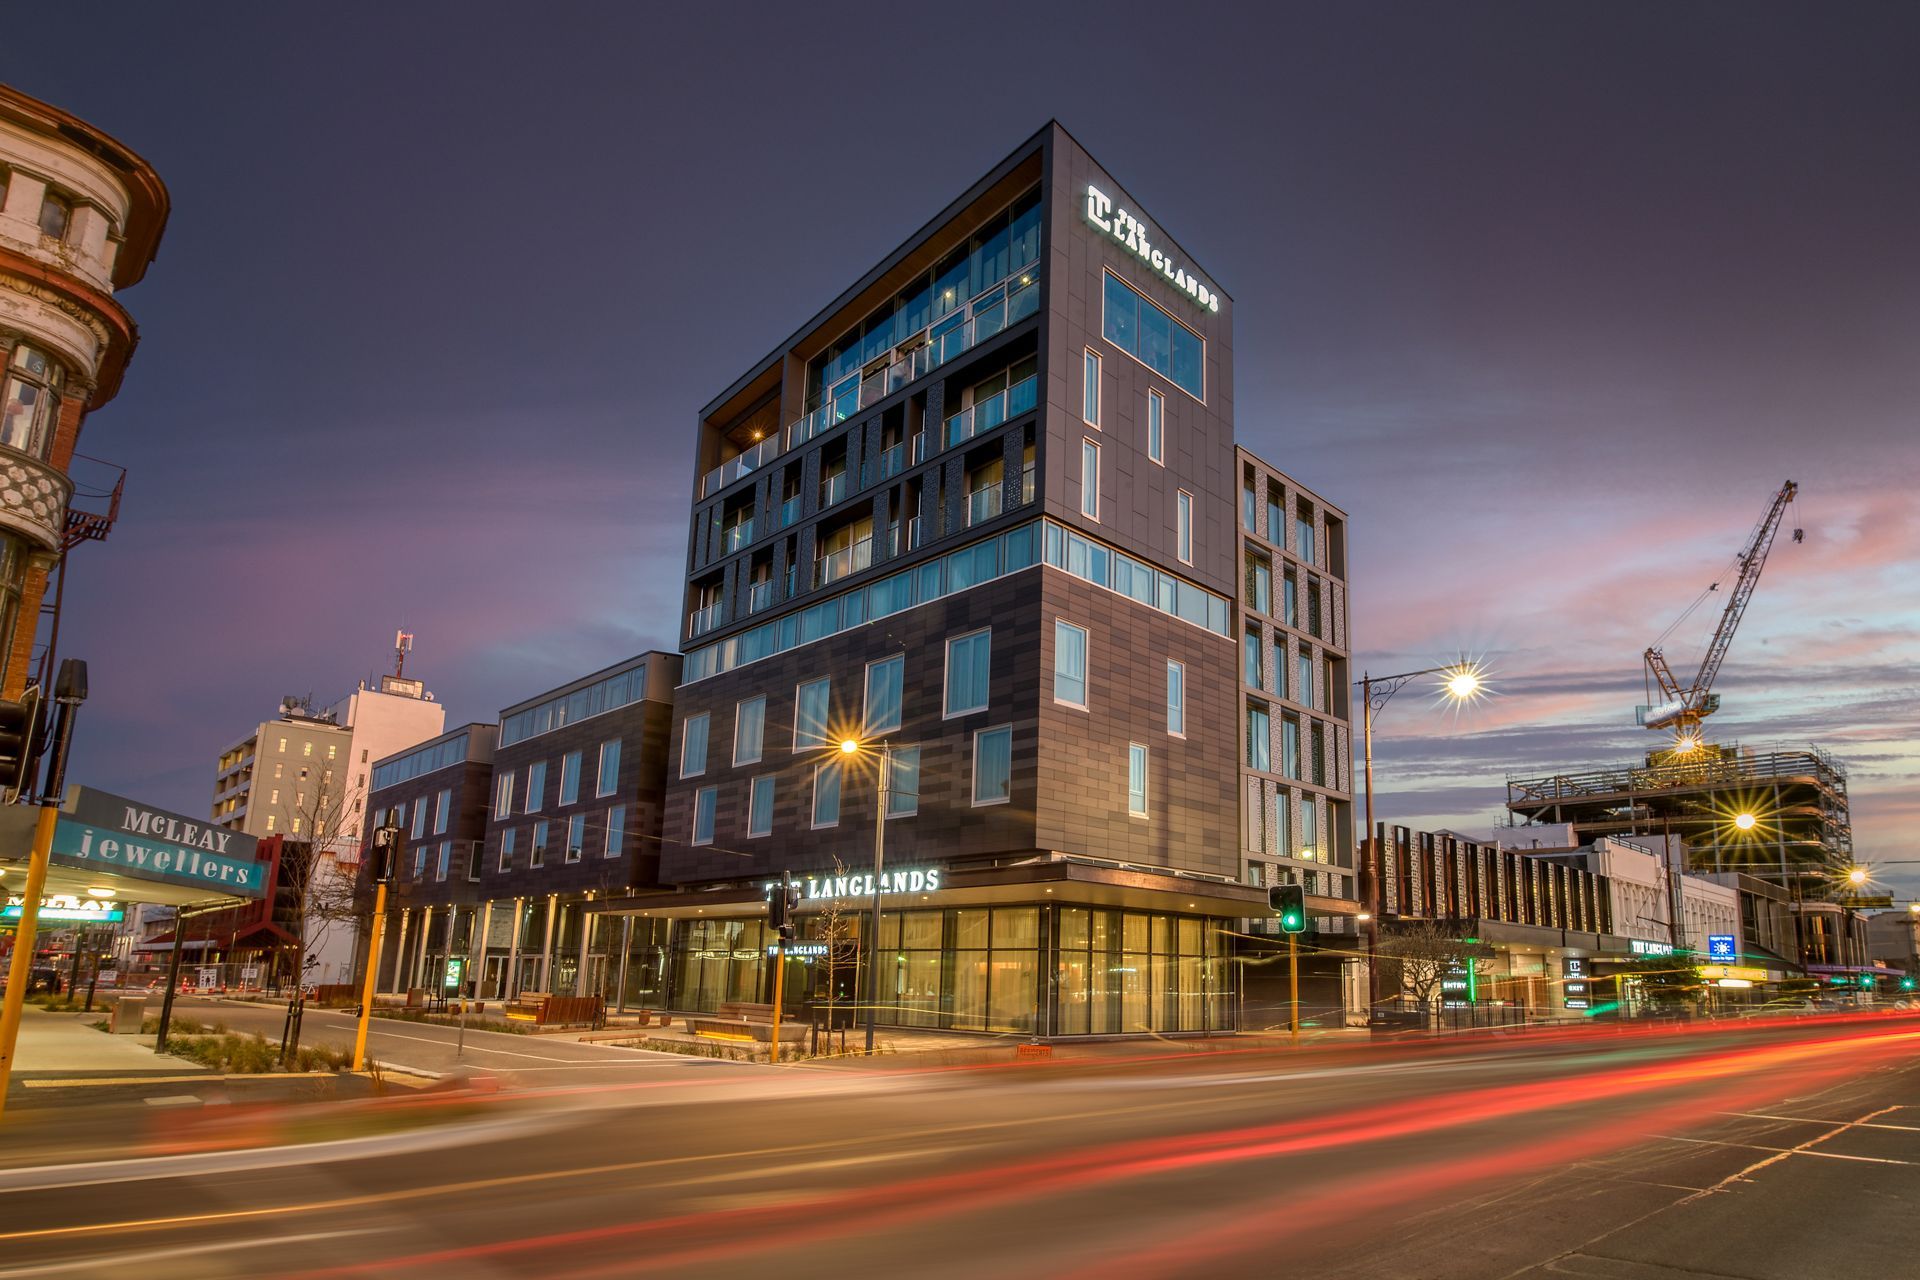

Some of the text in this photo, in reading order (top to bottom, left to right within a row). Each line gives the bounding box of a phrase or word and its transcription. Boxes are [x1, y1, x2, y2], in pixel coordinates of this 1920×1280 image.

[1118, 208, 1146, 239] THE
[1113, 218, 1218, 312] LANGLANDS
[121, 806, 231, 853] McLEAY
[76, 829, 249, 884] jewellers
[809, 869, 939, 899] LANGLANDS
[1443, 981, 1467, 989] ENTRY
